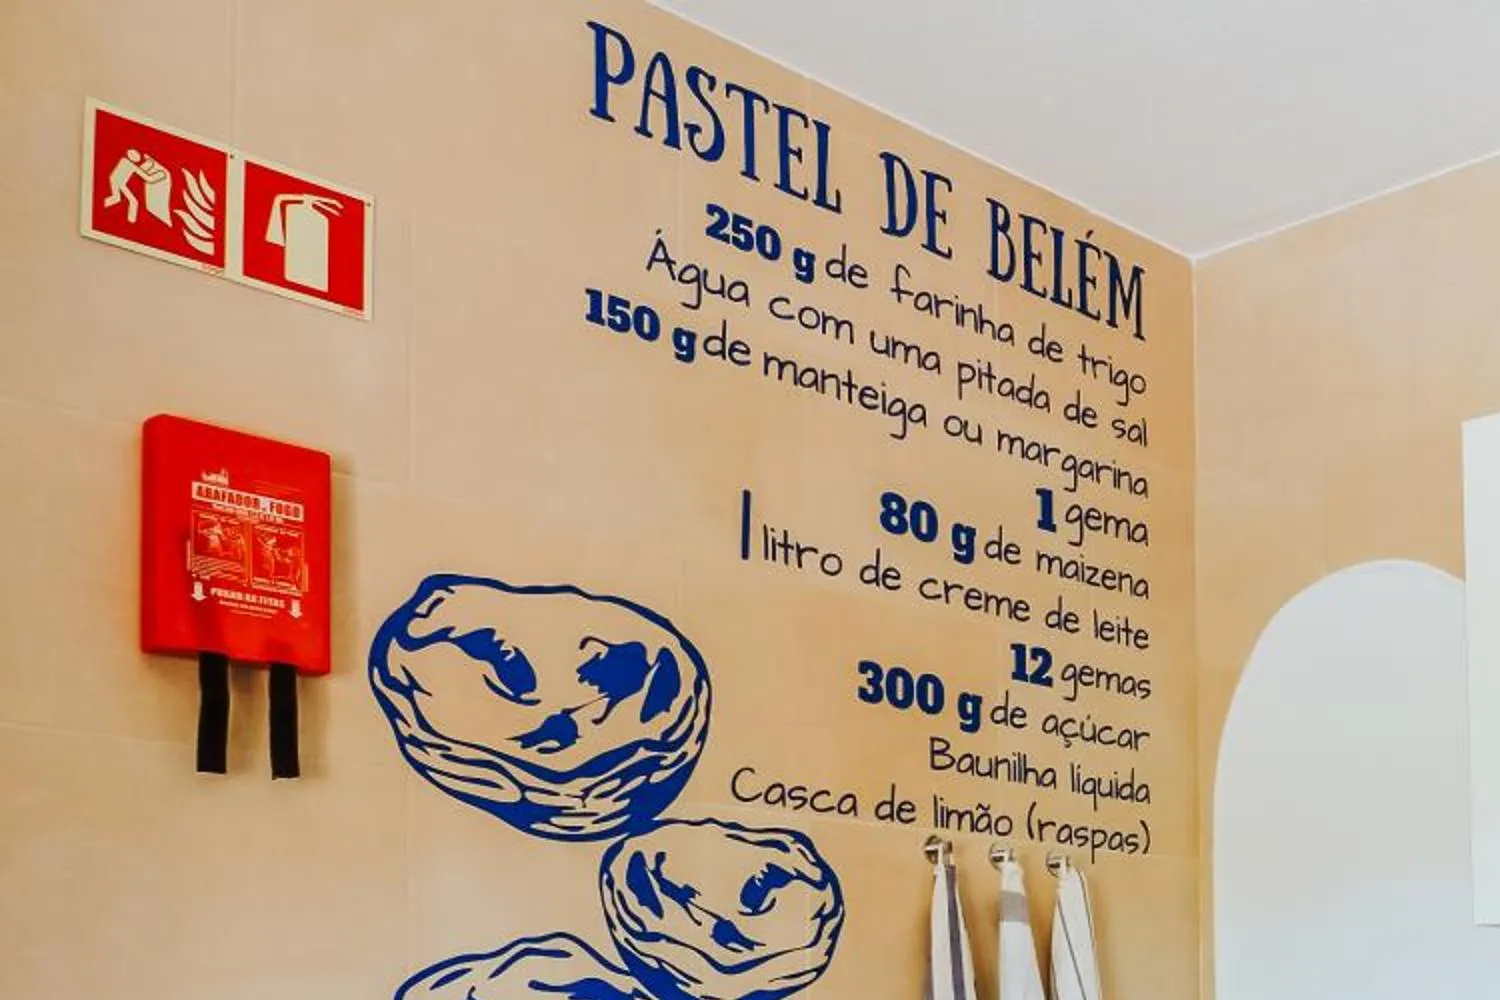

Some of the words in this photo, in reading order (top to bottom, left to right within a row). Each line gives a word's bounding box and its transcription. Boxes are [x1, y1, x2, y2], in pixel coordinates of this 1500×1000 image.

[586, 20, 843, 214] PASTEL
[879, 151, 953, 260] DE
[986, 197, 1146, 341] BELÉM
[645, 228, 751, 310] Água
[768, 296, 855, 344] com
[869, 330, 941, 374] uma
[957, 359, 1051, 413] pitada
[1064, 390, 1098, 428] de
[1111, 416, 1148, 448] sal
[705, 203, 782, 262] 250
[793, 248, 817, 284] g
[826, 244, 868, 288] de
[890, 264, 1015, 346] farinha
[1028, 323, 1063, 363] de
[1078, 344, 1147, 406] trigo
[584, 287, 660, 342] 150
[672, 327, 697, 364] g
[703, 320, 751, 367] de
[763, 350, 927, 440] manteiga
[943, 414, 983, 445] ou
[997, 429, 1149, 498] margarina
[880, 492, 938, 543] 80
[951, 523, 976, 564] g
[984, 525, 1021, 564] de
[1037, 548, 1149, 599] maizena
[1036, 488, 1057, 533] 1
[1065, 503, 1149, 547] gema
[763, 524, 843, 576] litro
[859, 548, 902, 590] de
[918, 575, 1031, 623] creme
[1045, 596, 1080, 634] de
[1093, 609, 1149, 649] leite
[857, 660, 945, 716] 300
[957, 692, 983, 734] g
[990, 690, 1028, 729] de
[1041, 714, 1151, 751] açúcar
[1010, 643, 1053, 688] 12
[1061, 662, 1151, 702] gemas
[731, 767, 858, 816] Casca
[875, 784, 917, 824] de
[933, 795, 1013, 837] limão
[1027, 802, 1151, 864] (raspas)
[929, 736, 1057, 789] Baunilha
